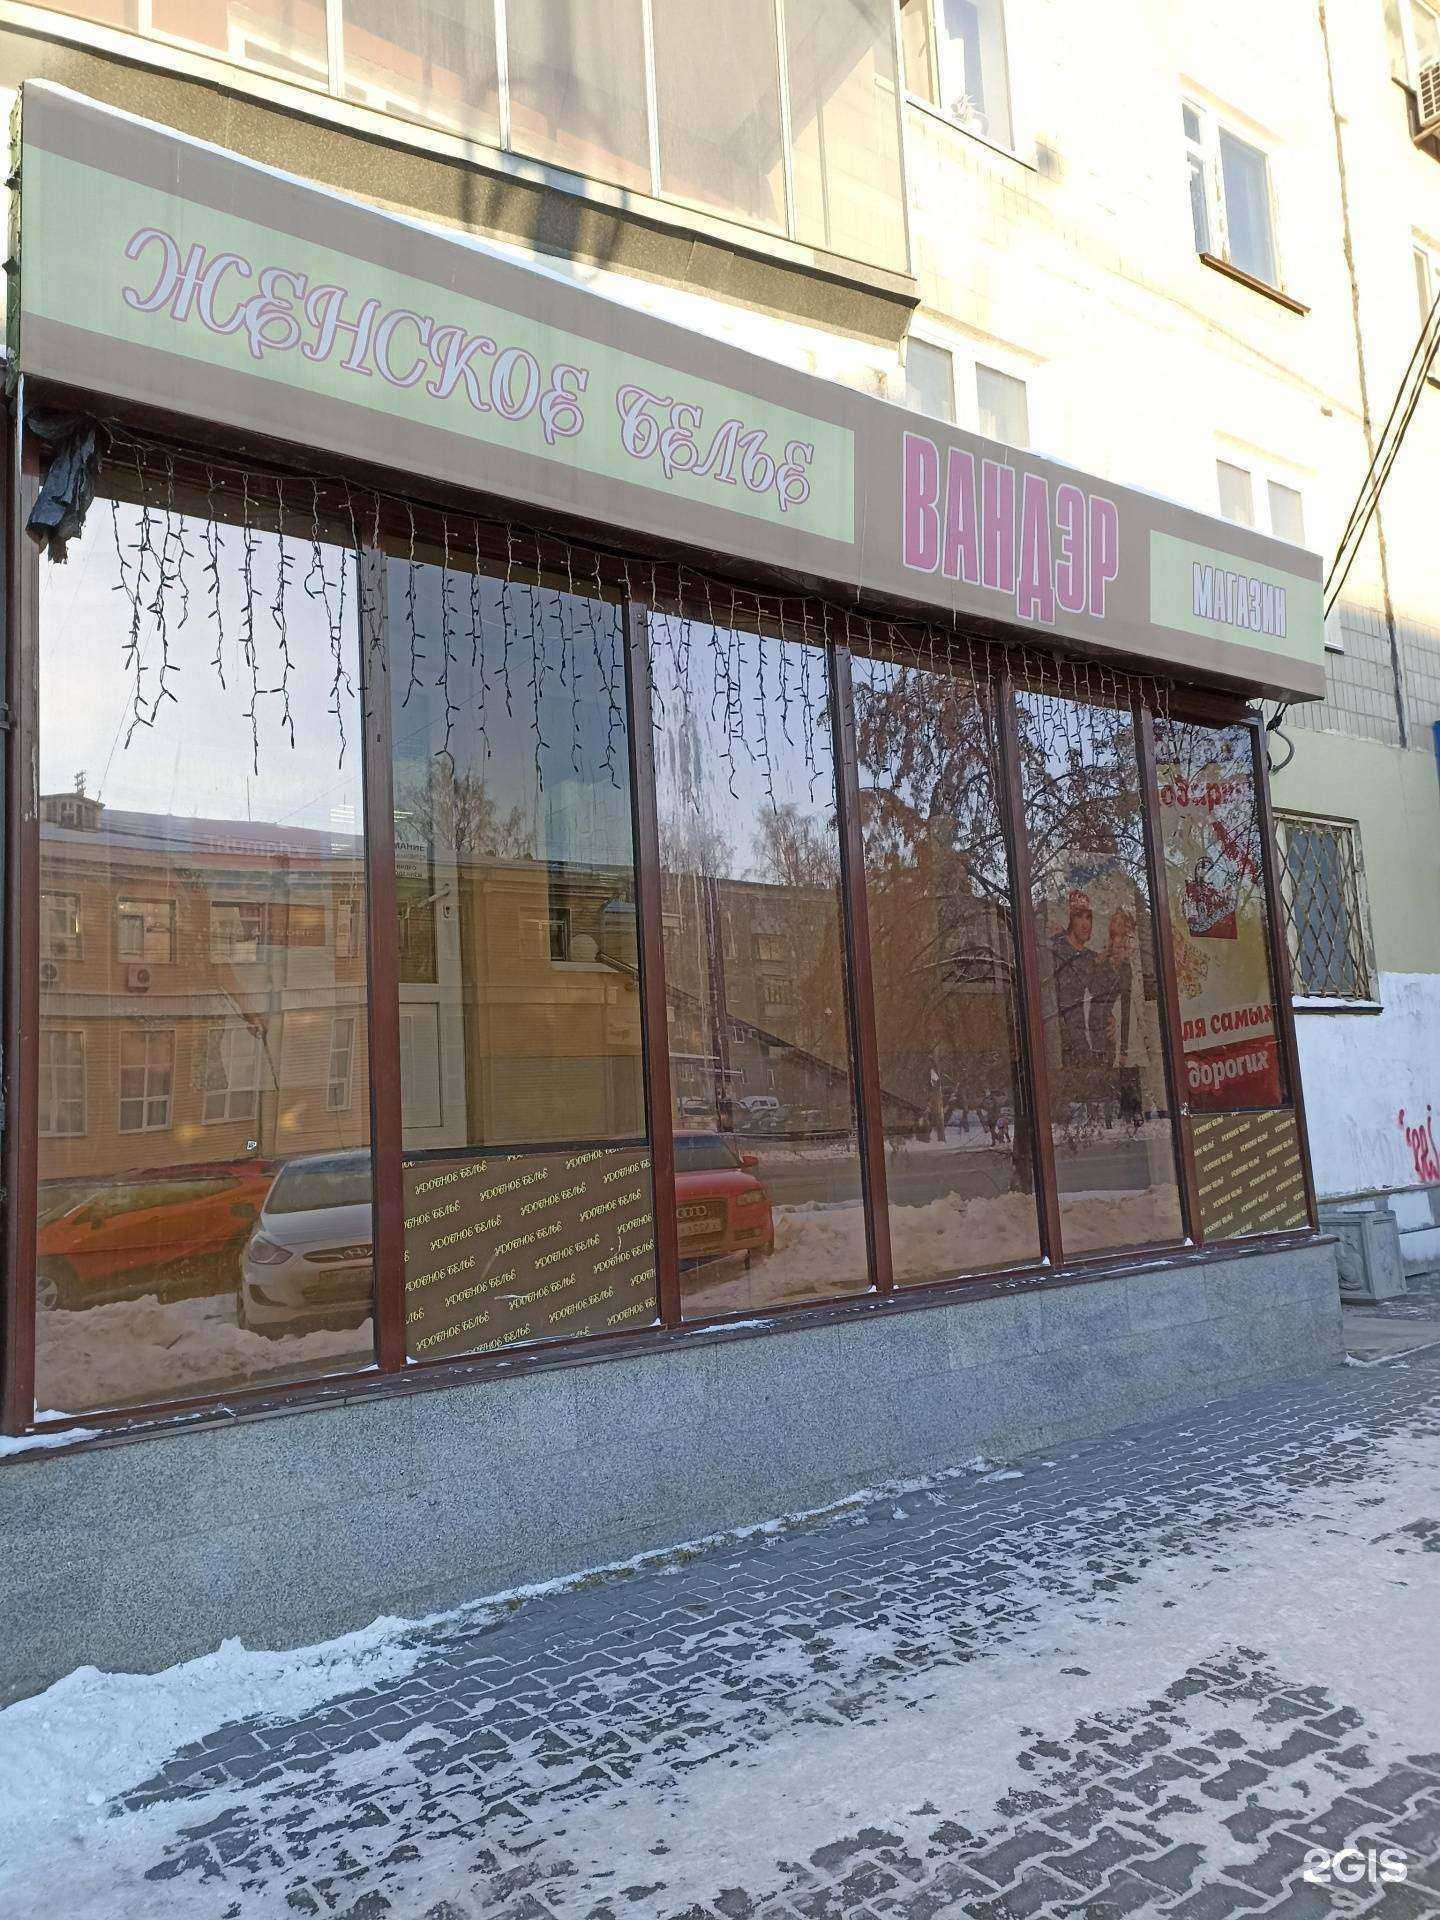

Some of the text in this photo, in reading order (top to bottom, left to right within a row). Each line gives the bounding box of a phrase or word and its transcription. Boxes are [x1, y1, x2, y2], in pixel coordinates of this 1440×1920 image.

[121, 226, 814, 512] ЖЕНСКОЕ БЕЛЬЕ
[903, 430, 1119, 626] ВАНДЭР
[1191, 561, 1287, 638] МАГАЗИН
[1211, 1003, 1273, 1034] самых
[1185, 1050, 1269, 1090] дорогих
[415, 1160, 488, 1195] УДОБНОЕ БЕЛЬЕ
[480, 1168, 548, 1202] УДОБНОЕ БЕЛЬЕ
[431, 1200, 461, 1219] БЕЛЬЕ
[520, 1181, 587, 1216] УДОБНОЕ БЕЛЬЕ
[578, 1188, 642, 1223] УДОБНОЕ БЕЛЬЕ
[430, 1215, 502, 1251] УДОБНОЕ БЕЛЬЕ
[494, 1221, 564, 1256] УДОБНОЕ БЕЛЬЕ
[447, 1256, 476, 1275] БЕЛЬЕ
[534, 1233, 601, 1269] УДОБНОЕ БЕЛЬЕ
[593, 1250, 631, 1274] УДОБНОЕ
[444, 1268, 517, 1307] УДОБНОЕ БЕЛЬЕ
[549, 1273, 576, 1293] БЕЛЬЕ
[548, 1285, 614, 1323] УДОБНОЕ БЕЛЬЕ
[415, 1310, 490, 1352] УДОБНОЕ БЕЛЬЕ
